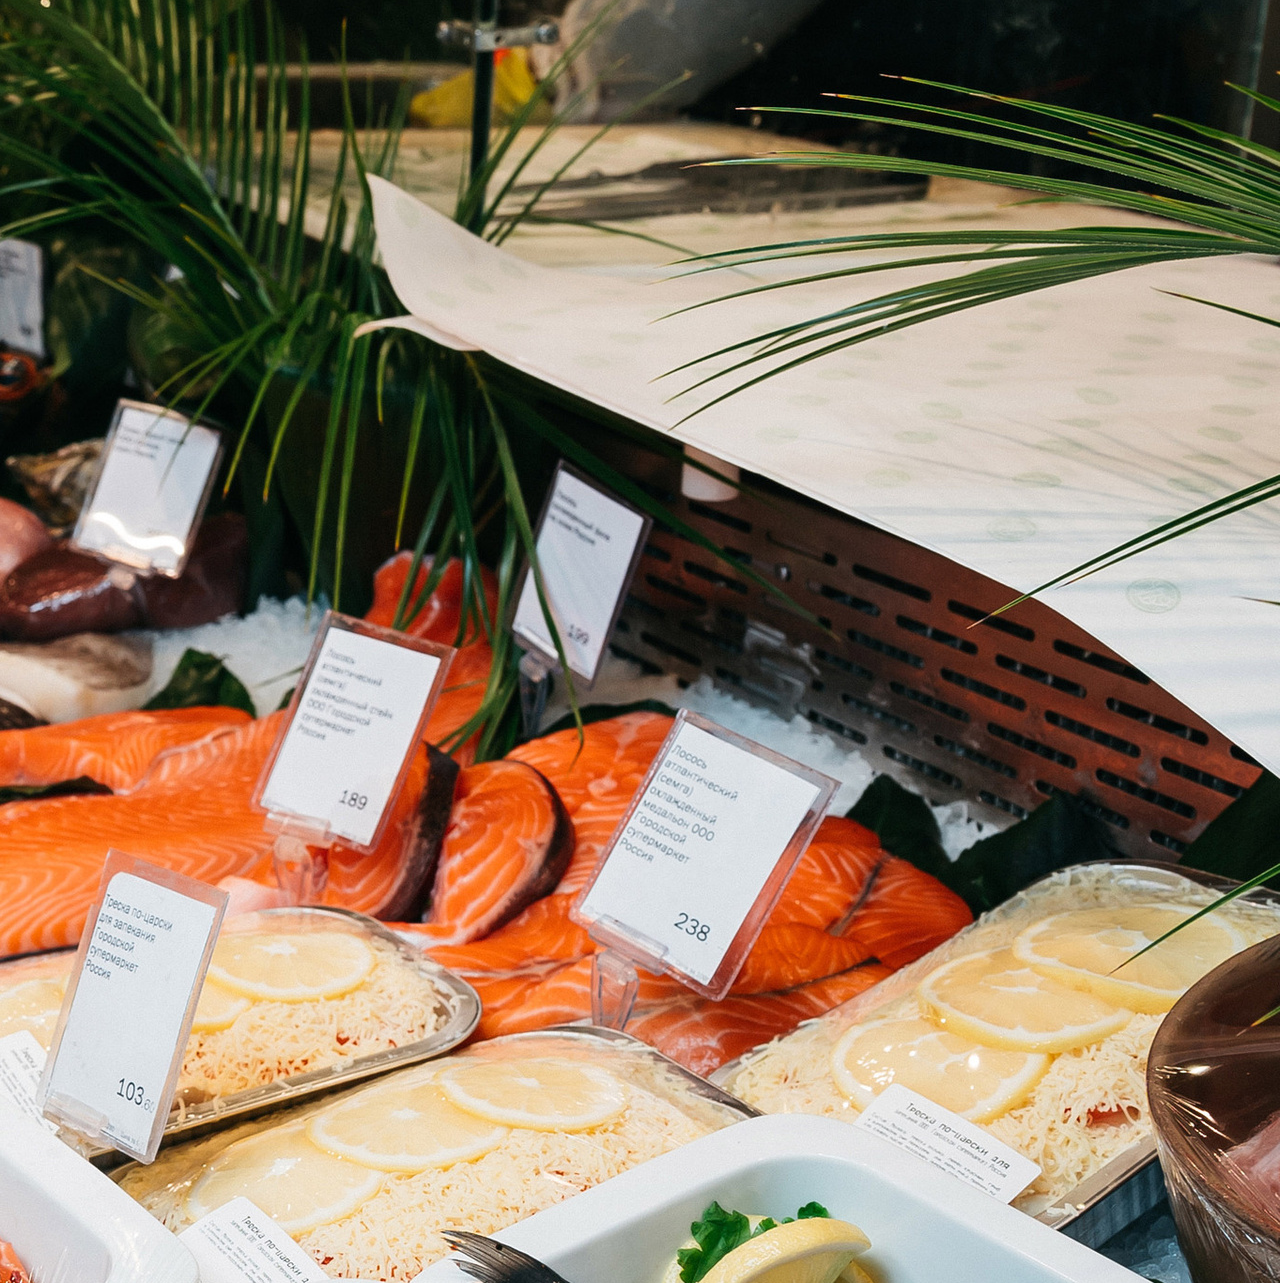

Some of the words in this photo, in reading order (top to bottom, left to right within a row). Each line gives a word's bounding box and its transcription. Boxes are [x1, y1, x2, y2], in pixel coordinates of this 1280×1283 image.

[671, 743, 708, 770] Лосось
[656, 772, 694, 797] (семга)
[664, 759, 739, 801] атлантический
[339, 789, 369, 811] 189
[649, 785, 718, 826] охлажденный
[634, 810, 687, 845] Городской
[643, 798, 690, 829] медальон
[691, 822, 715, 842] ООО
[619, 837, 654, 863] Россия
[626, 825, 690, 864] супермаркет
[99, 911, 112, 928] для
[113, 918, 156, 944] запекания
[104, 893, 131, 916] Треска
[132, 905, 173, 932] по-царски
[674, 911, 711, 942] 238
[95, 926, 135, 954] Городской
[85, 960, 111, 981] Россия
[89, 944, 139, 975] супермаркет
[906, 1102, 936, 1125] Треска
[938, 1122, 989, 1156] по-царски
[991, 1155, 1011, 1170] для
[241, 1216, 265, 1239] Треска
[264, 1239, 303, 1276] по-царски
